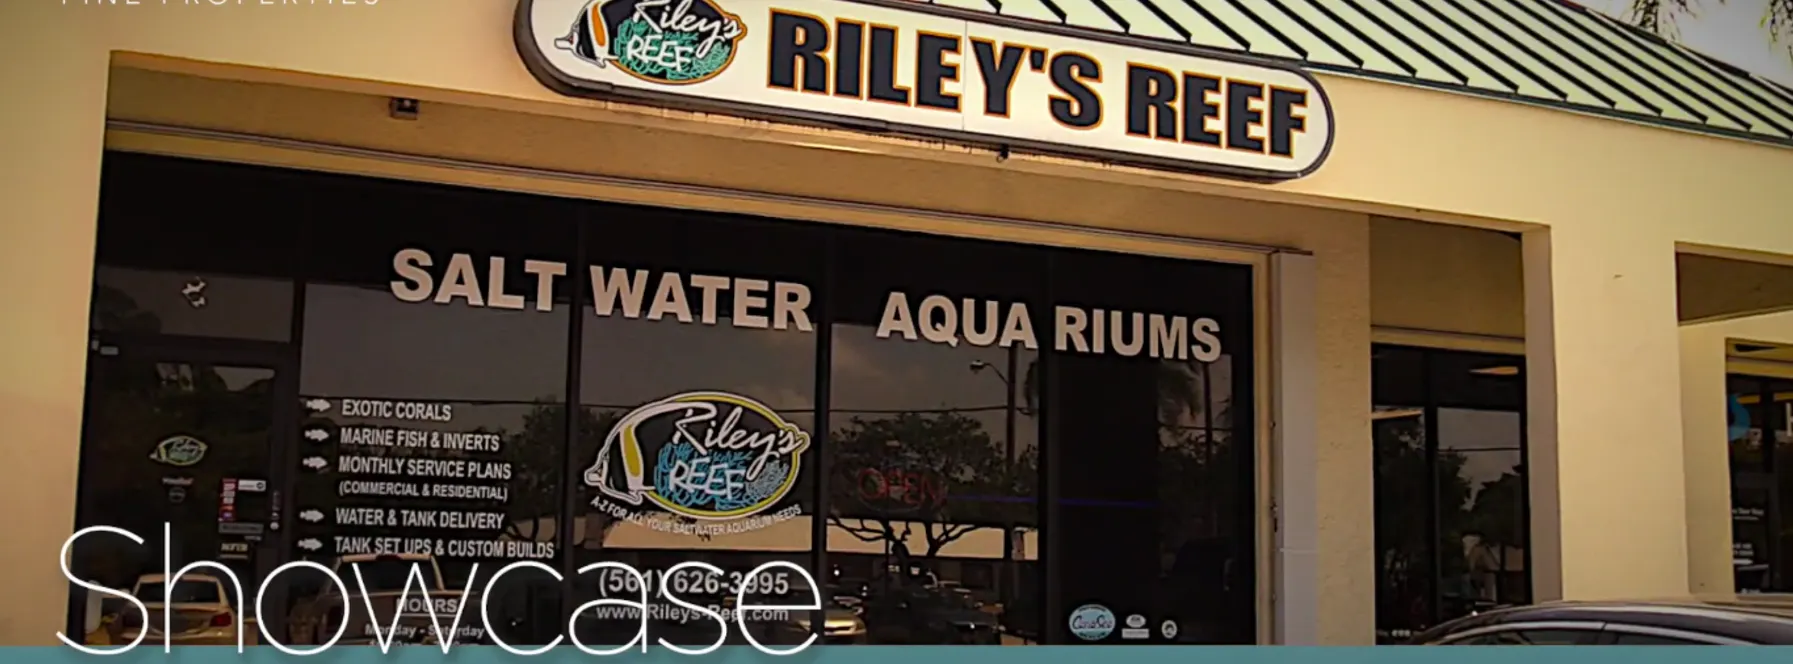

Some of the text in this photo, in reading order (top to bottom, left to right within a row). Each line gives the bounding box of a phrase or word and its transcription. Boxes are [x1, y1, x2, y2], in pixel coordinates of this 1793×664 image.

[633, 0, 743, 59] Riley's
[627, 34, 694, 72] REEF
[767, 5, 1310, 159] RILEY'S REEF
[390, 248, 1222, 363] SALT WATER AQUA RIUMS
[341, 399, 452, 421] EXOTIC CORALS
[340, 427, 501, 451] MARINE FISH & INVERTS
[672, 403, 804, 481] Riley's
[338, 455, 512, 480] MONTHLY SERVICE PLANS
[669, 457, 745, 500] REEF
[339, 480, 508, 502] (COMMERCIAL & RESIDENTIAL)
[335, 507, 505, 529] WATER & TANK DELIVERY
[607, 501, 626, 519] FOR
[647, 518, 672, 533] YOUR
[673, 521, 725, 536] SALTWATER
[726, 515, 772, 533] AQUARIUM
[773, 503, 802, 524] NEEDS
[334, 536, 555, 559] TANK SET UPS & CUSTOM BUILDS
[599, 569, 789, 598] (561) 626-3995
[597, 604, 789, 623] wwwRileys-Ree.com
[428, 624, 485, 639] Satrday
